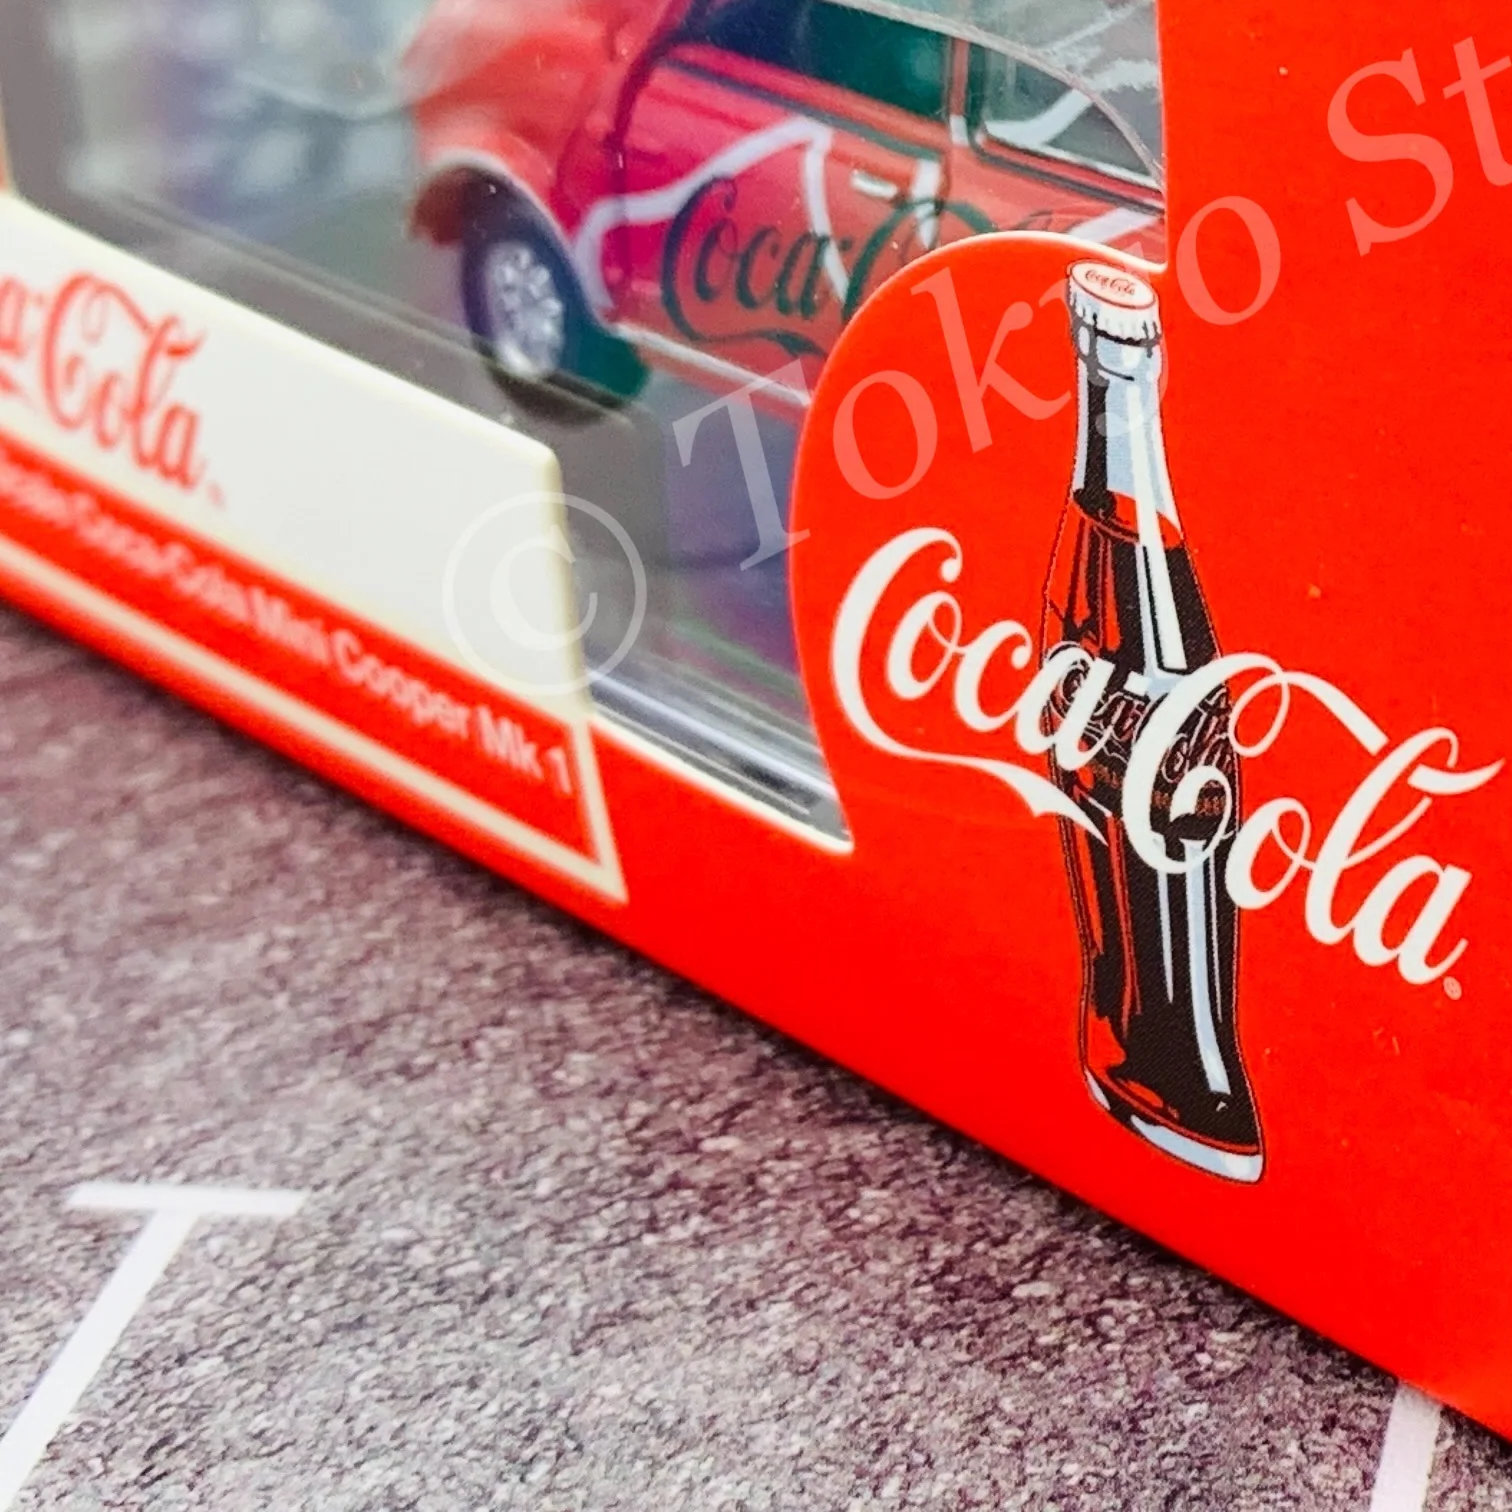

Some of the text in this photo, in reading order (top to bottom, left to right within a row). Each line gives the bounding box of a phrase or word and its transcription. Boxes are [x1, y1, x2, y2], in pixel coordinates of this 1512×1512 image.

[332, 628, 469, 739] Cooper
[476, 703, 544, 782] Mk
[545, 746, 574, 795] 1
[831, 526, 1506, 985] Coca-Cola
